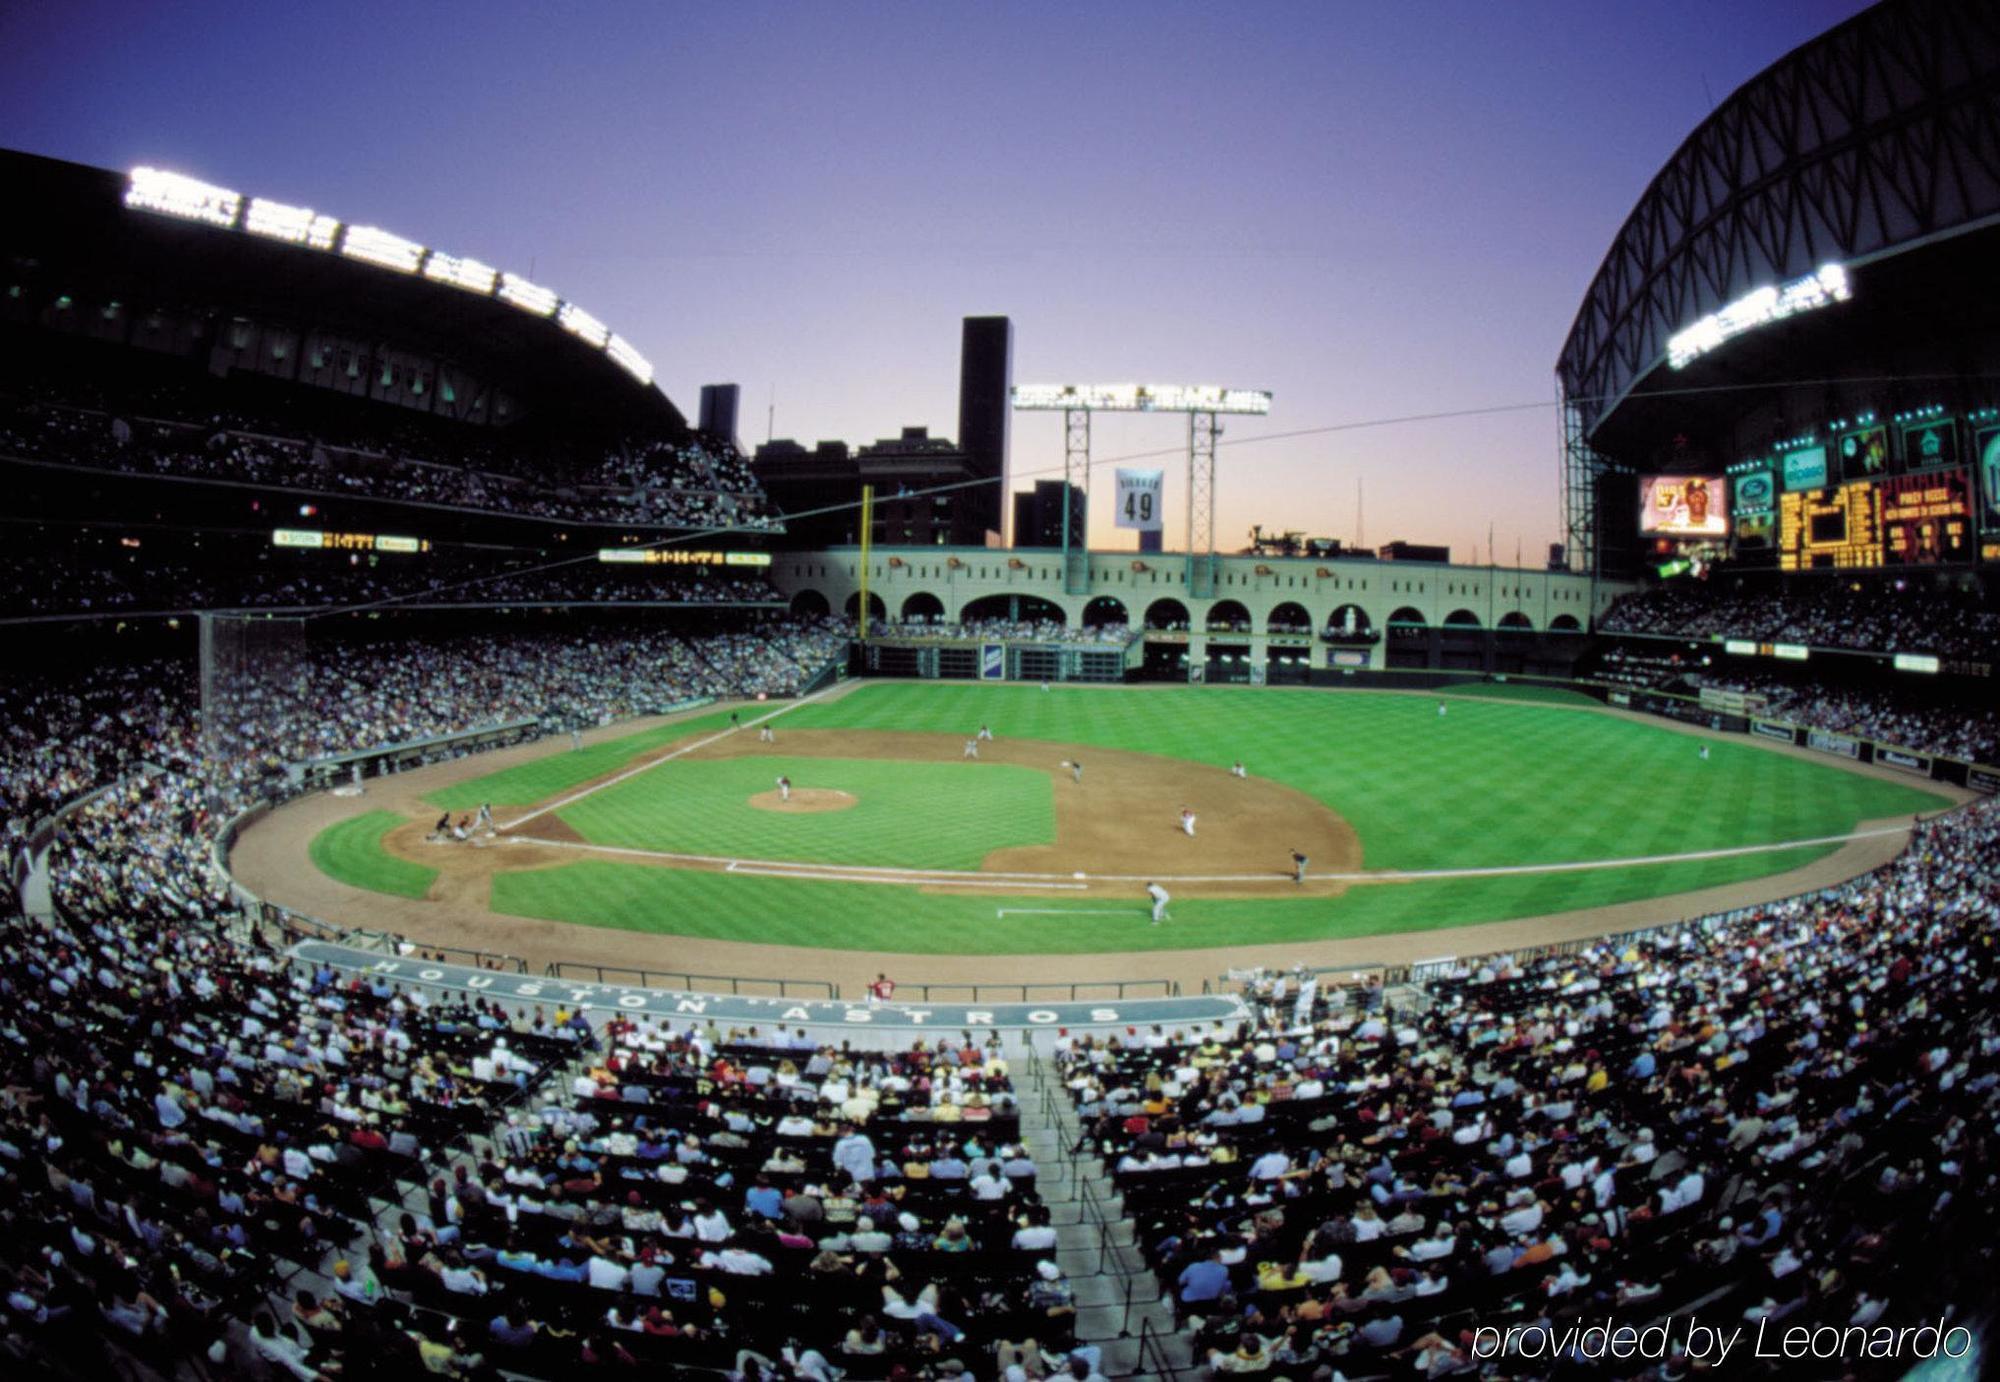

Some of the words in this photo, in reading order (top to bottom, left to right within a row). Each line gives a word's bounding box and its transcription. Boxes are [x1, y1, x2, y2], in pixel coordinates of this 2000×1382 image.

[1124, 491, 1153, 522] 49
[374, 961, 707, 1014] HOUSTON
[782, 1006, 1120, 1025] ASTROS
